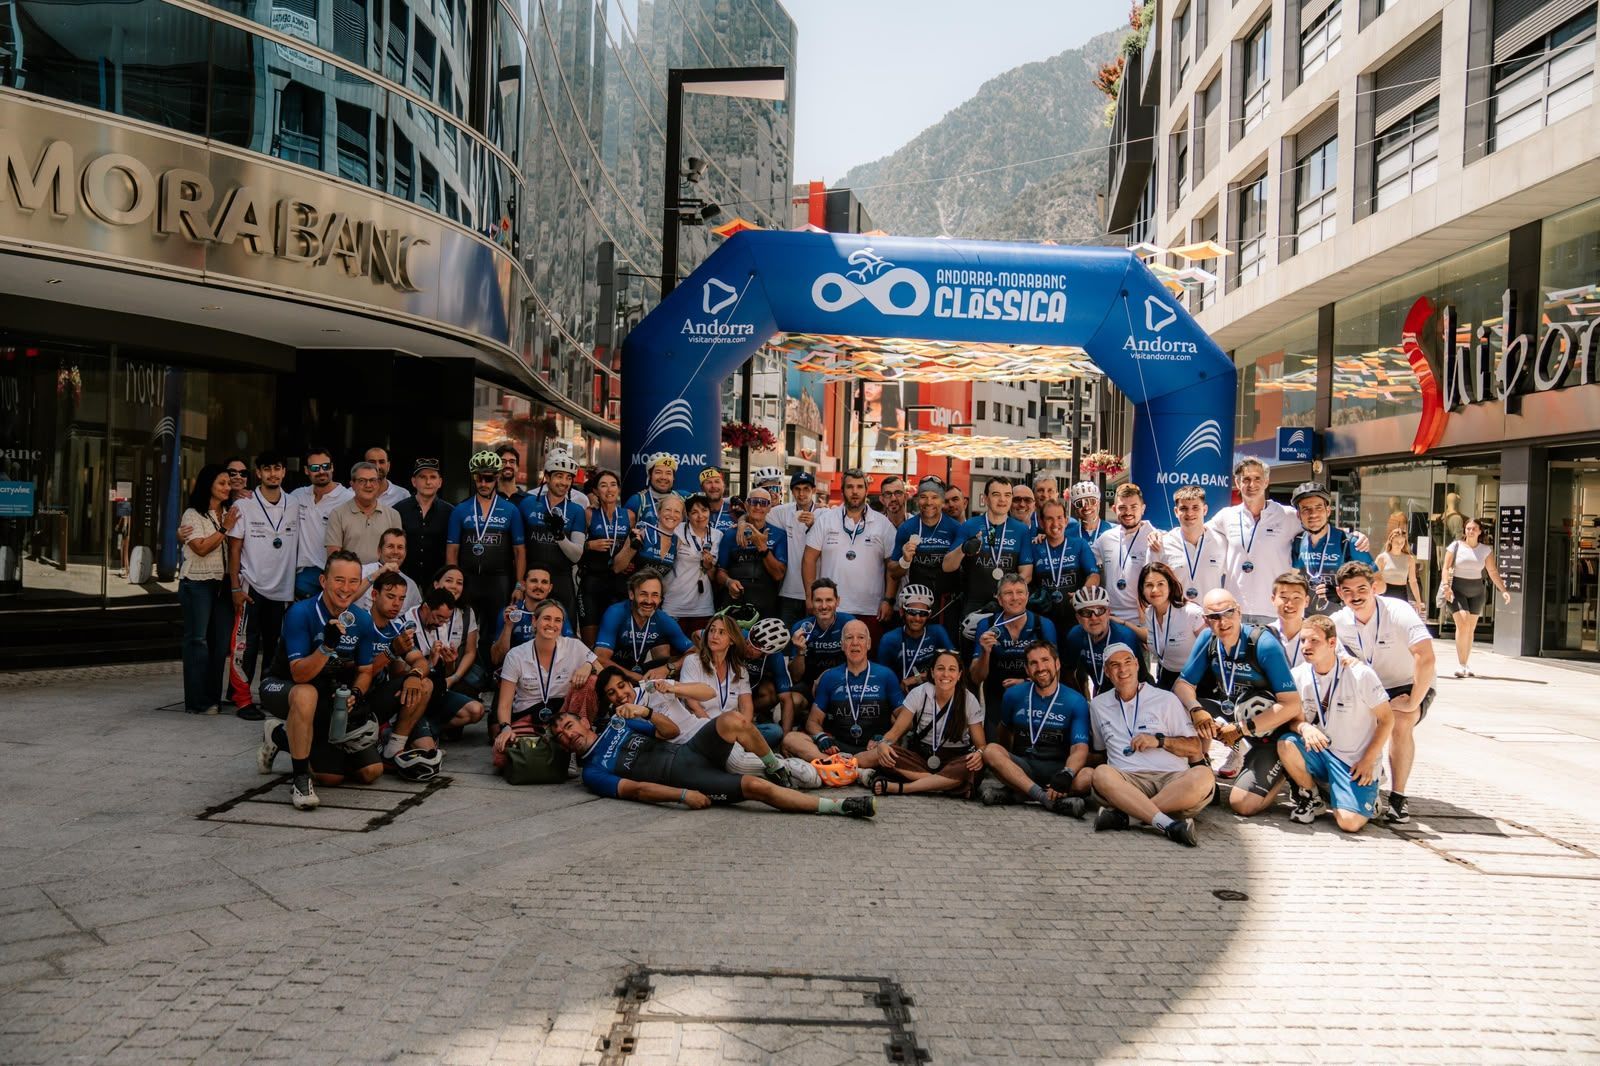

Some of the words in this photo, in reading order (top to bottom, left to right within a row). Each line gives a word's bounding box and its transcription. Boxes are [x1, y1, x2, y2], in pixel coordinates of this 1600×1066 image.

[0, 130, 431, 292] MORABANC
[681, 319, 754, 336] Andorra
[688, 335, 746, 344] visitandorra.com
[1122, 335, 1198, 354] Andorra
[1130, 352, 1192, 361] visitandorra.com
[632, 454, 707, 466] MOBANC
[663, 459, 672, 467] 43
[701, 470, 713, 479] 127
[1157, 472, 1230, 488] MORABANC
